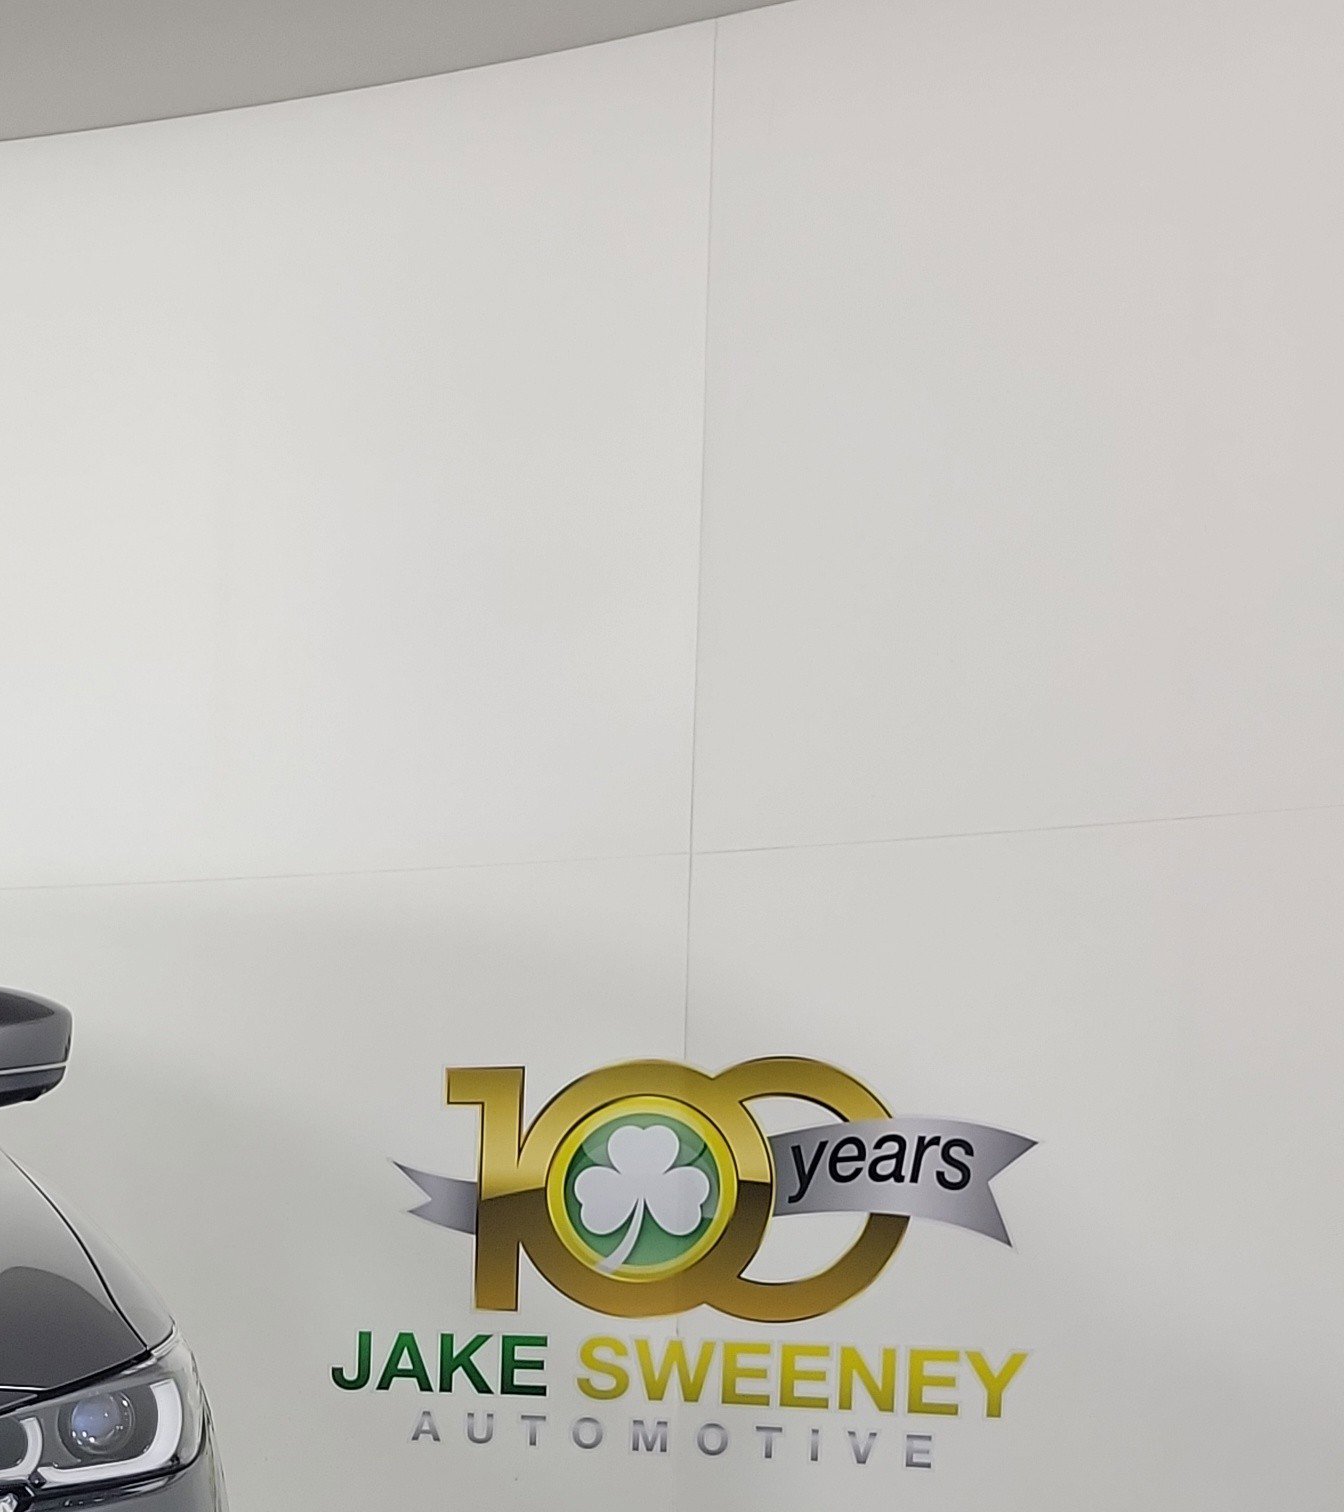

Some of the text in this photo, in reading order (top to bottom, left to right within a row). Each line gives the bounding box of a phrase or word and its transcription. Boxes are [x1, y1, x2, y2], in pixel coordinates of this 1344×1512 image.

[445, 1056, 975, 1322] 100 years
[331, 1331, 1028, 1419] JAKE SWEENEY
[411, 1411, 933, 1469] AUTOMOTIVE
